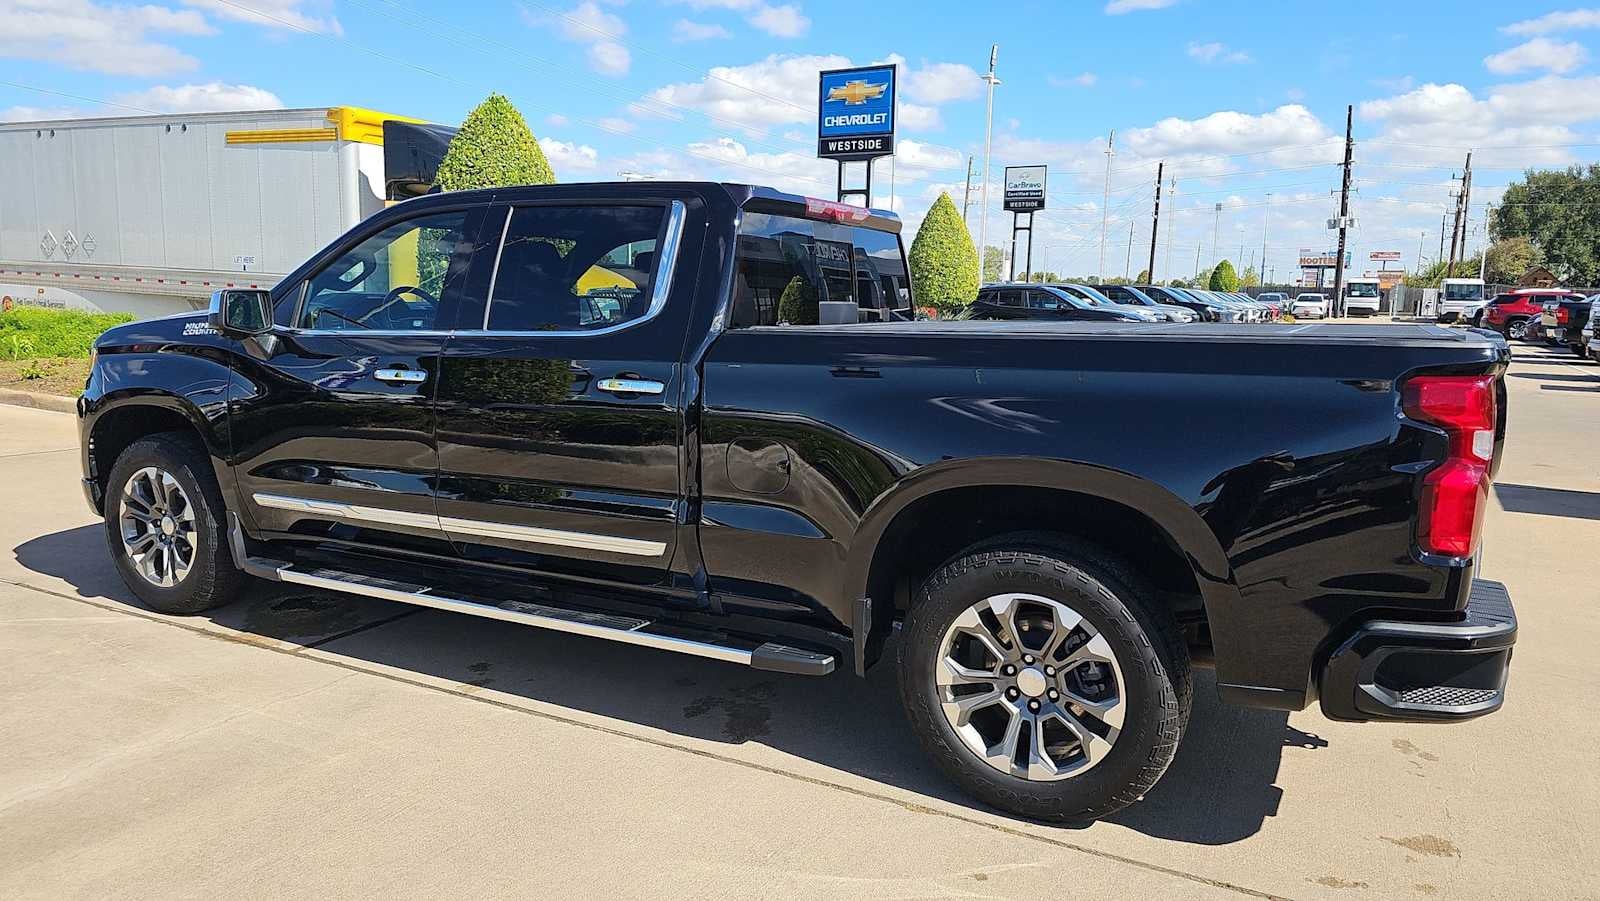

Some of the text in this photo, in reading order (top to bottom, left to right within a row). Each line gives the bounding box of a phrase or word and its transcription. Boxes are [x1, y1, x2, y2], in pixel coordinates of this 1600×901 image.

[824, 113, 888, 127] CHEVROLET
[828, 139, 882, 151] WESTSIDE
[1008, 181, 1042, 189] CarBravo
